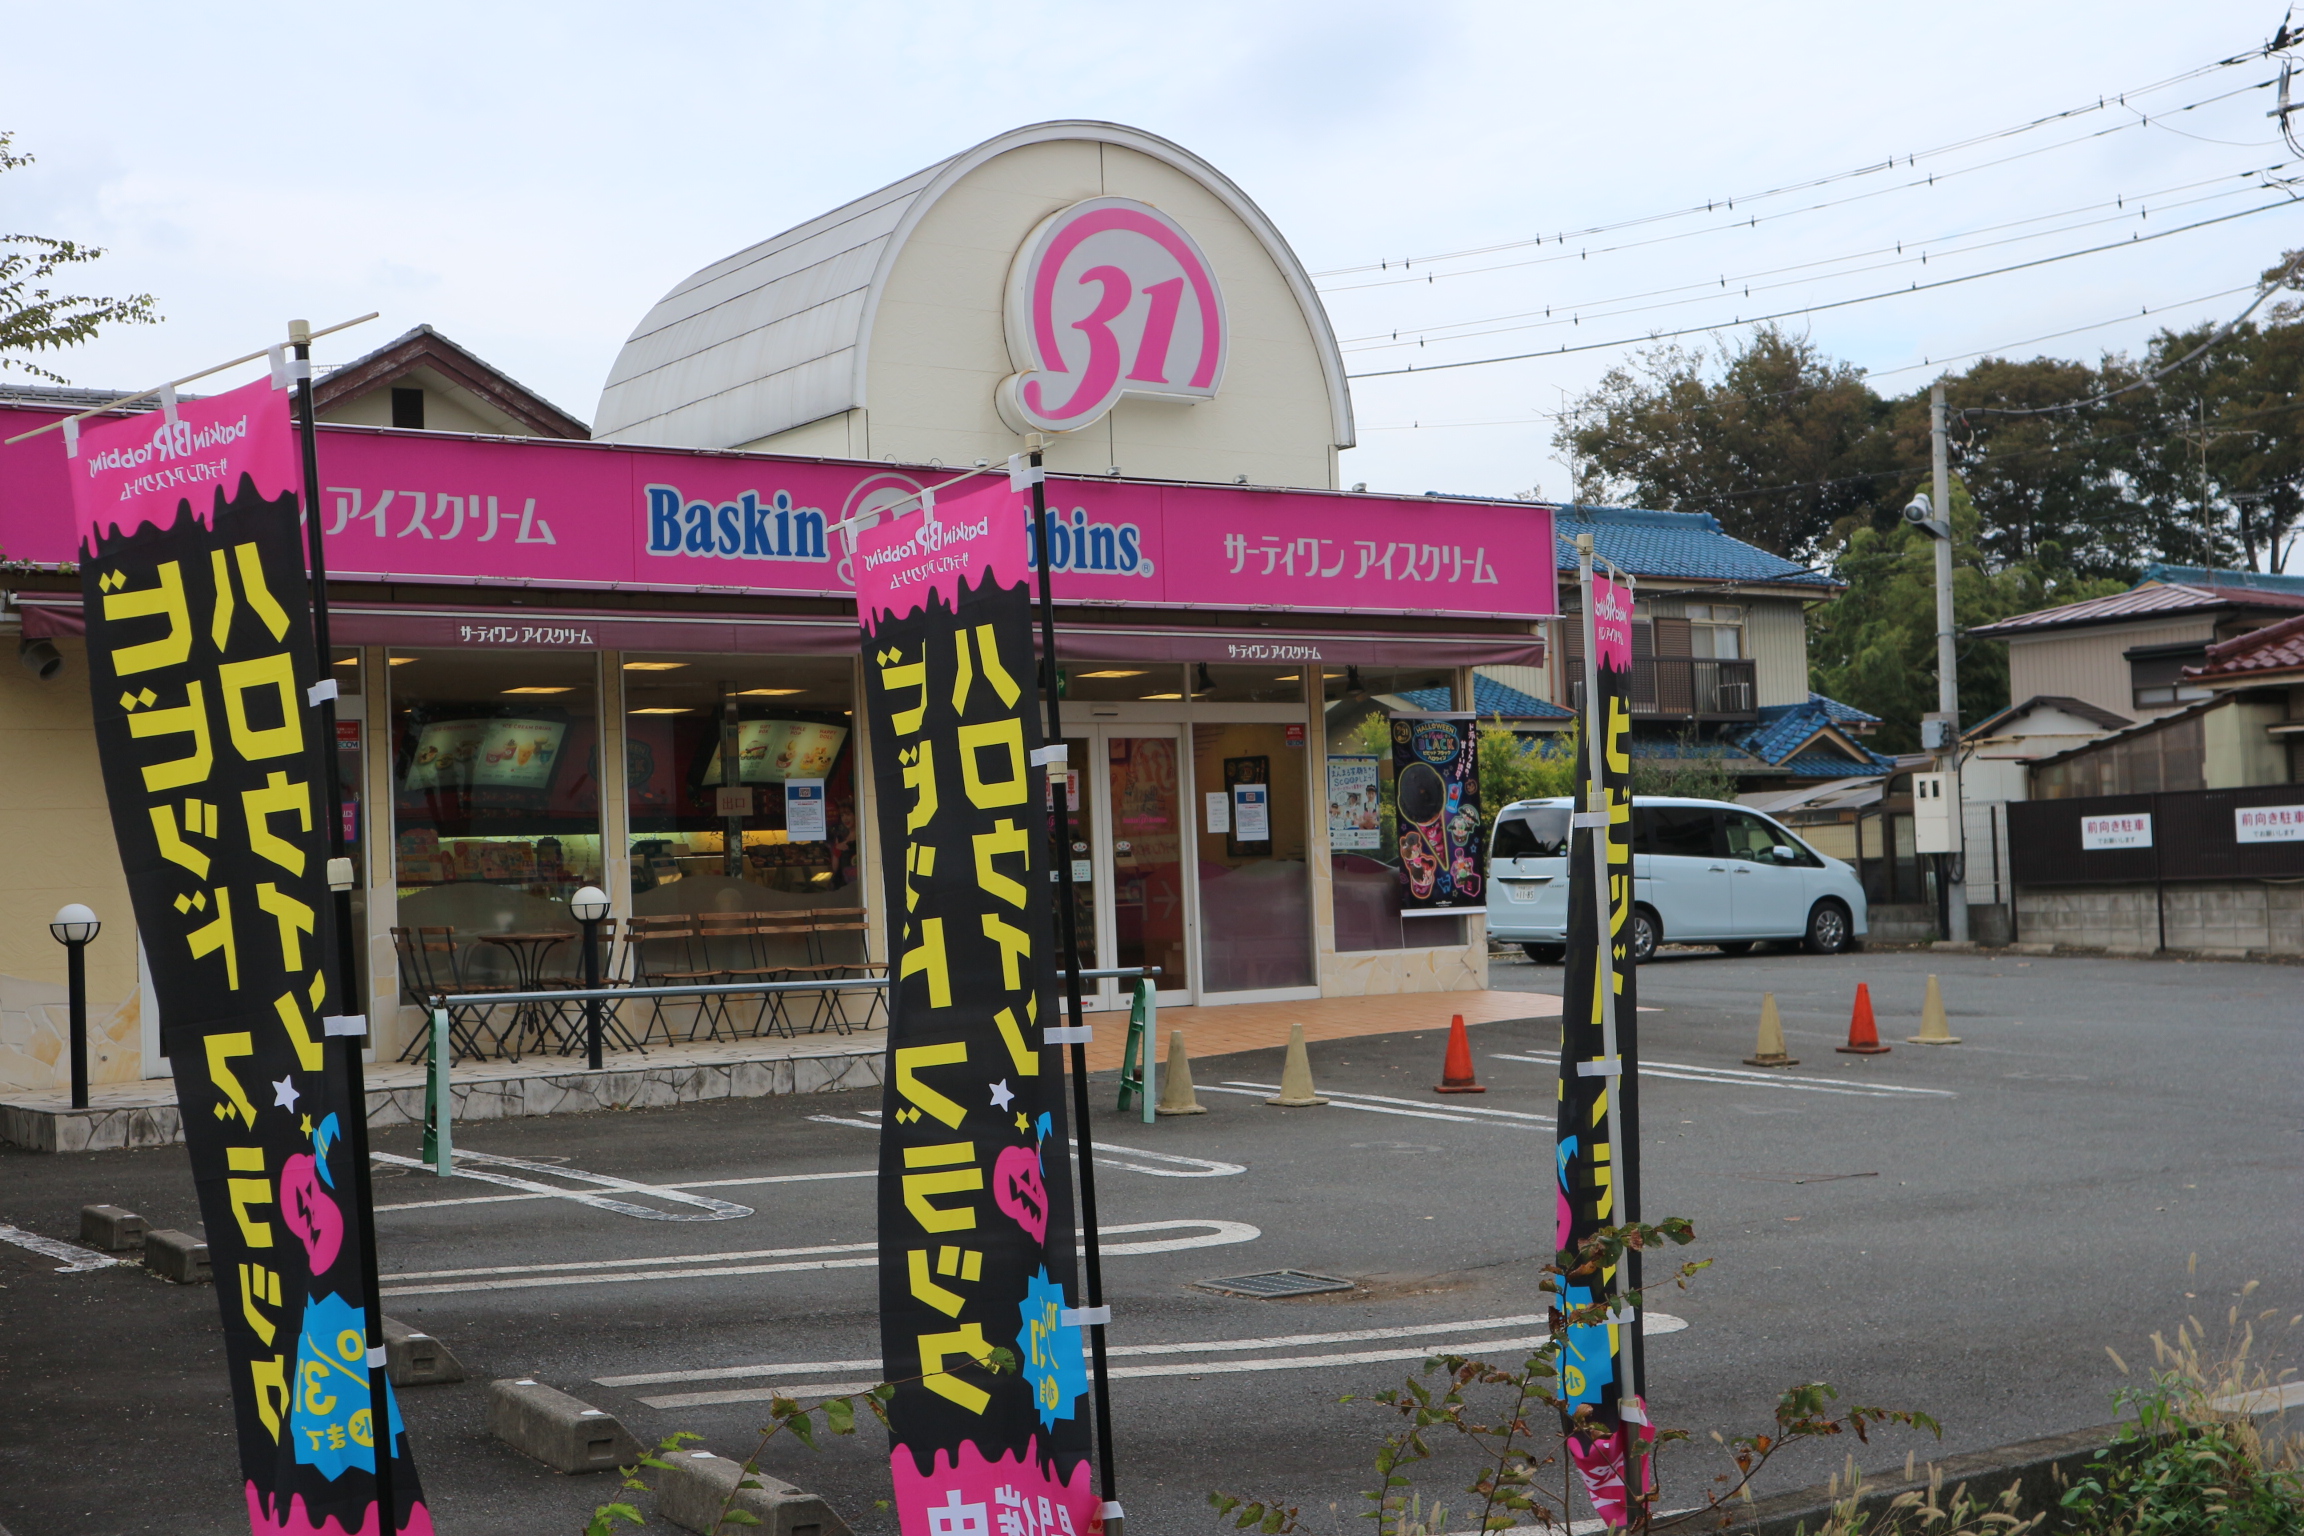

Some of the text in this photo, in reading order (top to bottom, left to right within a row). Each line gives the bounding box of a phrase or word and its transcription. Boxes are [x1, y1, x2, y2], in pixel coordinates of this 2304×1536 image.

[1023, 264, 1185, 421] 31
[325, 486, 558, 546] アイスクリーム
[646, 486, 828, 560] Baskin
[1023, 508, 1140, 573] bbins
[1223, 533, 1499, 585] サーティワン アイスクリーム
[460, 625, 594, 645] サーティワン アイスクリーム
[1227, 644, 1322, 660] サーティワン アイスクリーム
[1415, 722, 1455, 734] HALLOWEEN
[1417, 738, 1455, 751] BLACK
[722, 796, 746, 811] 出口
[2087, 818, 2145, 834] 前向き駐車
[2242, 809, 2304, 827] 前向き駐車
